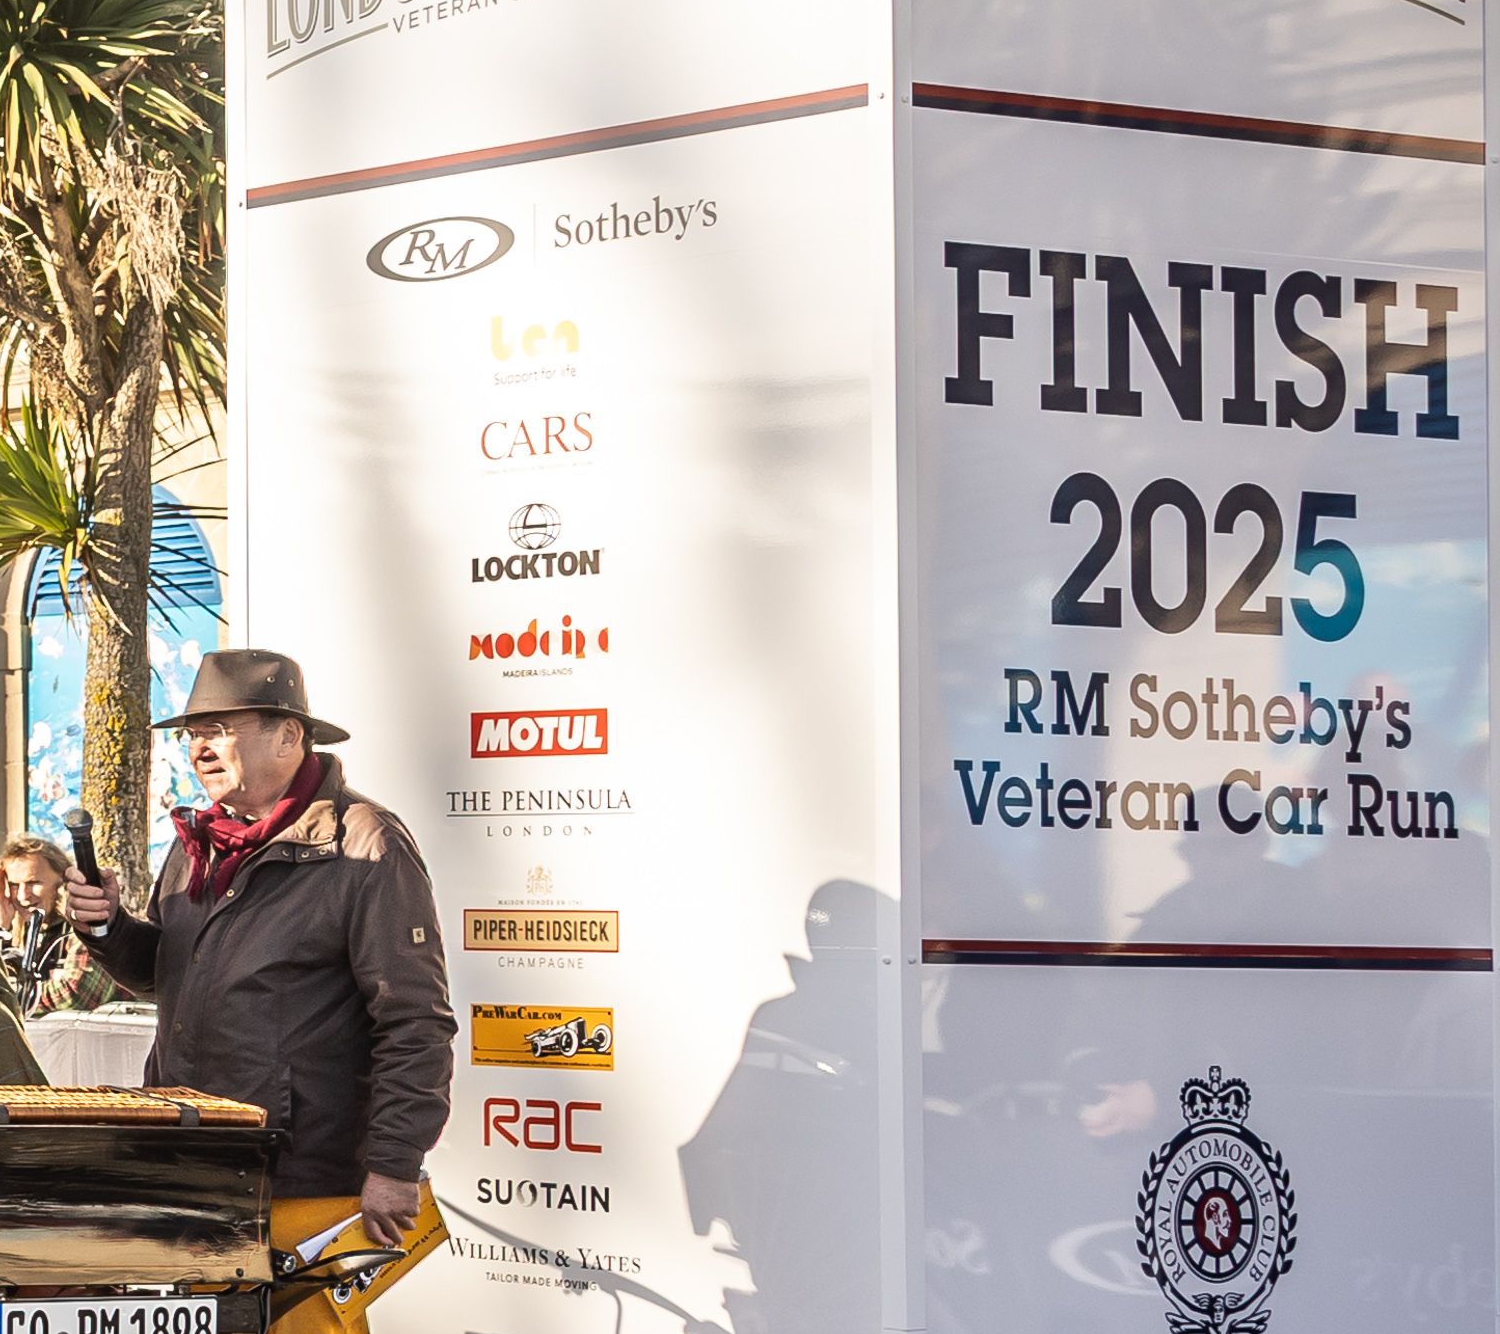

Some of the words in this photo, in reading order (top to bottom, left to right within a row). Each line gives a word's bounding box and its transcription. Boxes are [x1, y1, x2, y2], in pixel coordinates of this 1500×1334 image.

[399, 228, 476, 274] RM
[554, 196, 719, 249] Sotheby's
[944, 241, 1460, 440] FINISH
[481, 412, 593, 460] CARS
[472, 549, 601, 583] LOCKTON
[1049, 472, 1366, 643] 2025
[476, 714, 603, 752] MOTUL
[1003, 668, 1109, 737] RM
[1129, 672, 1411, 763] Sotheby's
[447, 791, 491, 811] THE
[502, 789, 631, 811] PENINSULA
[954, 760, 1199, 832] Veteran
[1218, 769, 1328, 835] Car
[1347, 773, 1459, 840] Run
[487, 825, 592, 837] LONDON
[473, 919, 609, 942] PIPER-HEIDSIECK
[498, 956, 585, 969] CHAMPAGNE
[1167, 1139, 1274, 1206] AUTOMOBILE
[449, 1236, 549, 1265] WILLIAMS
[555, 1250, 571, 1267] &
[577, 1248, 642, 1274] YATES
[1158, 1200, 1187, 1284] ROYAL
[1249, 1215, 1275, 1283] CLUB
[486, 1272, 519, 1284] TAILOR
[523, 1275, 551, 1288] MADE
[555, 1278, 597, 1291] MOVING
